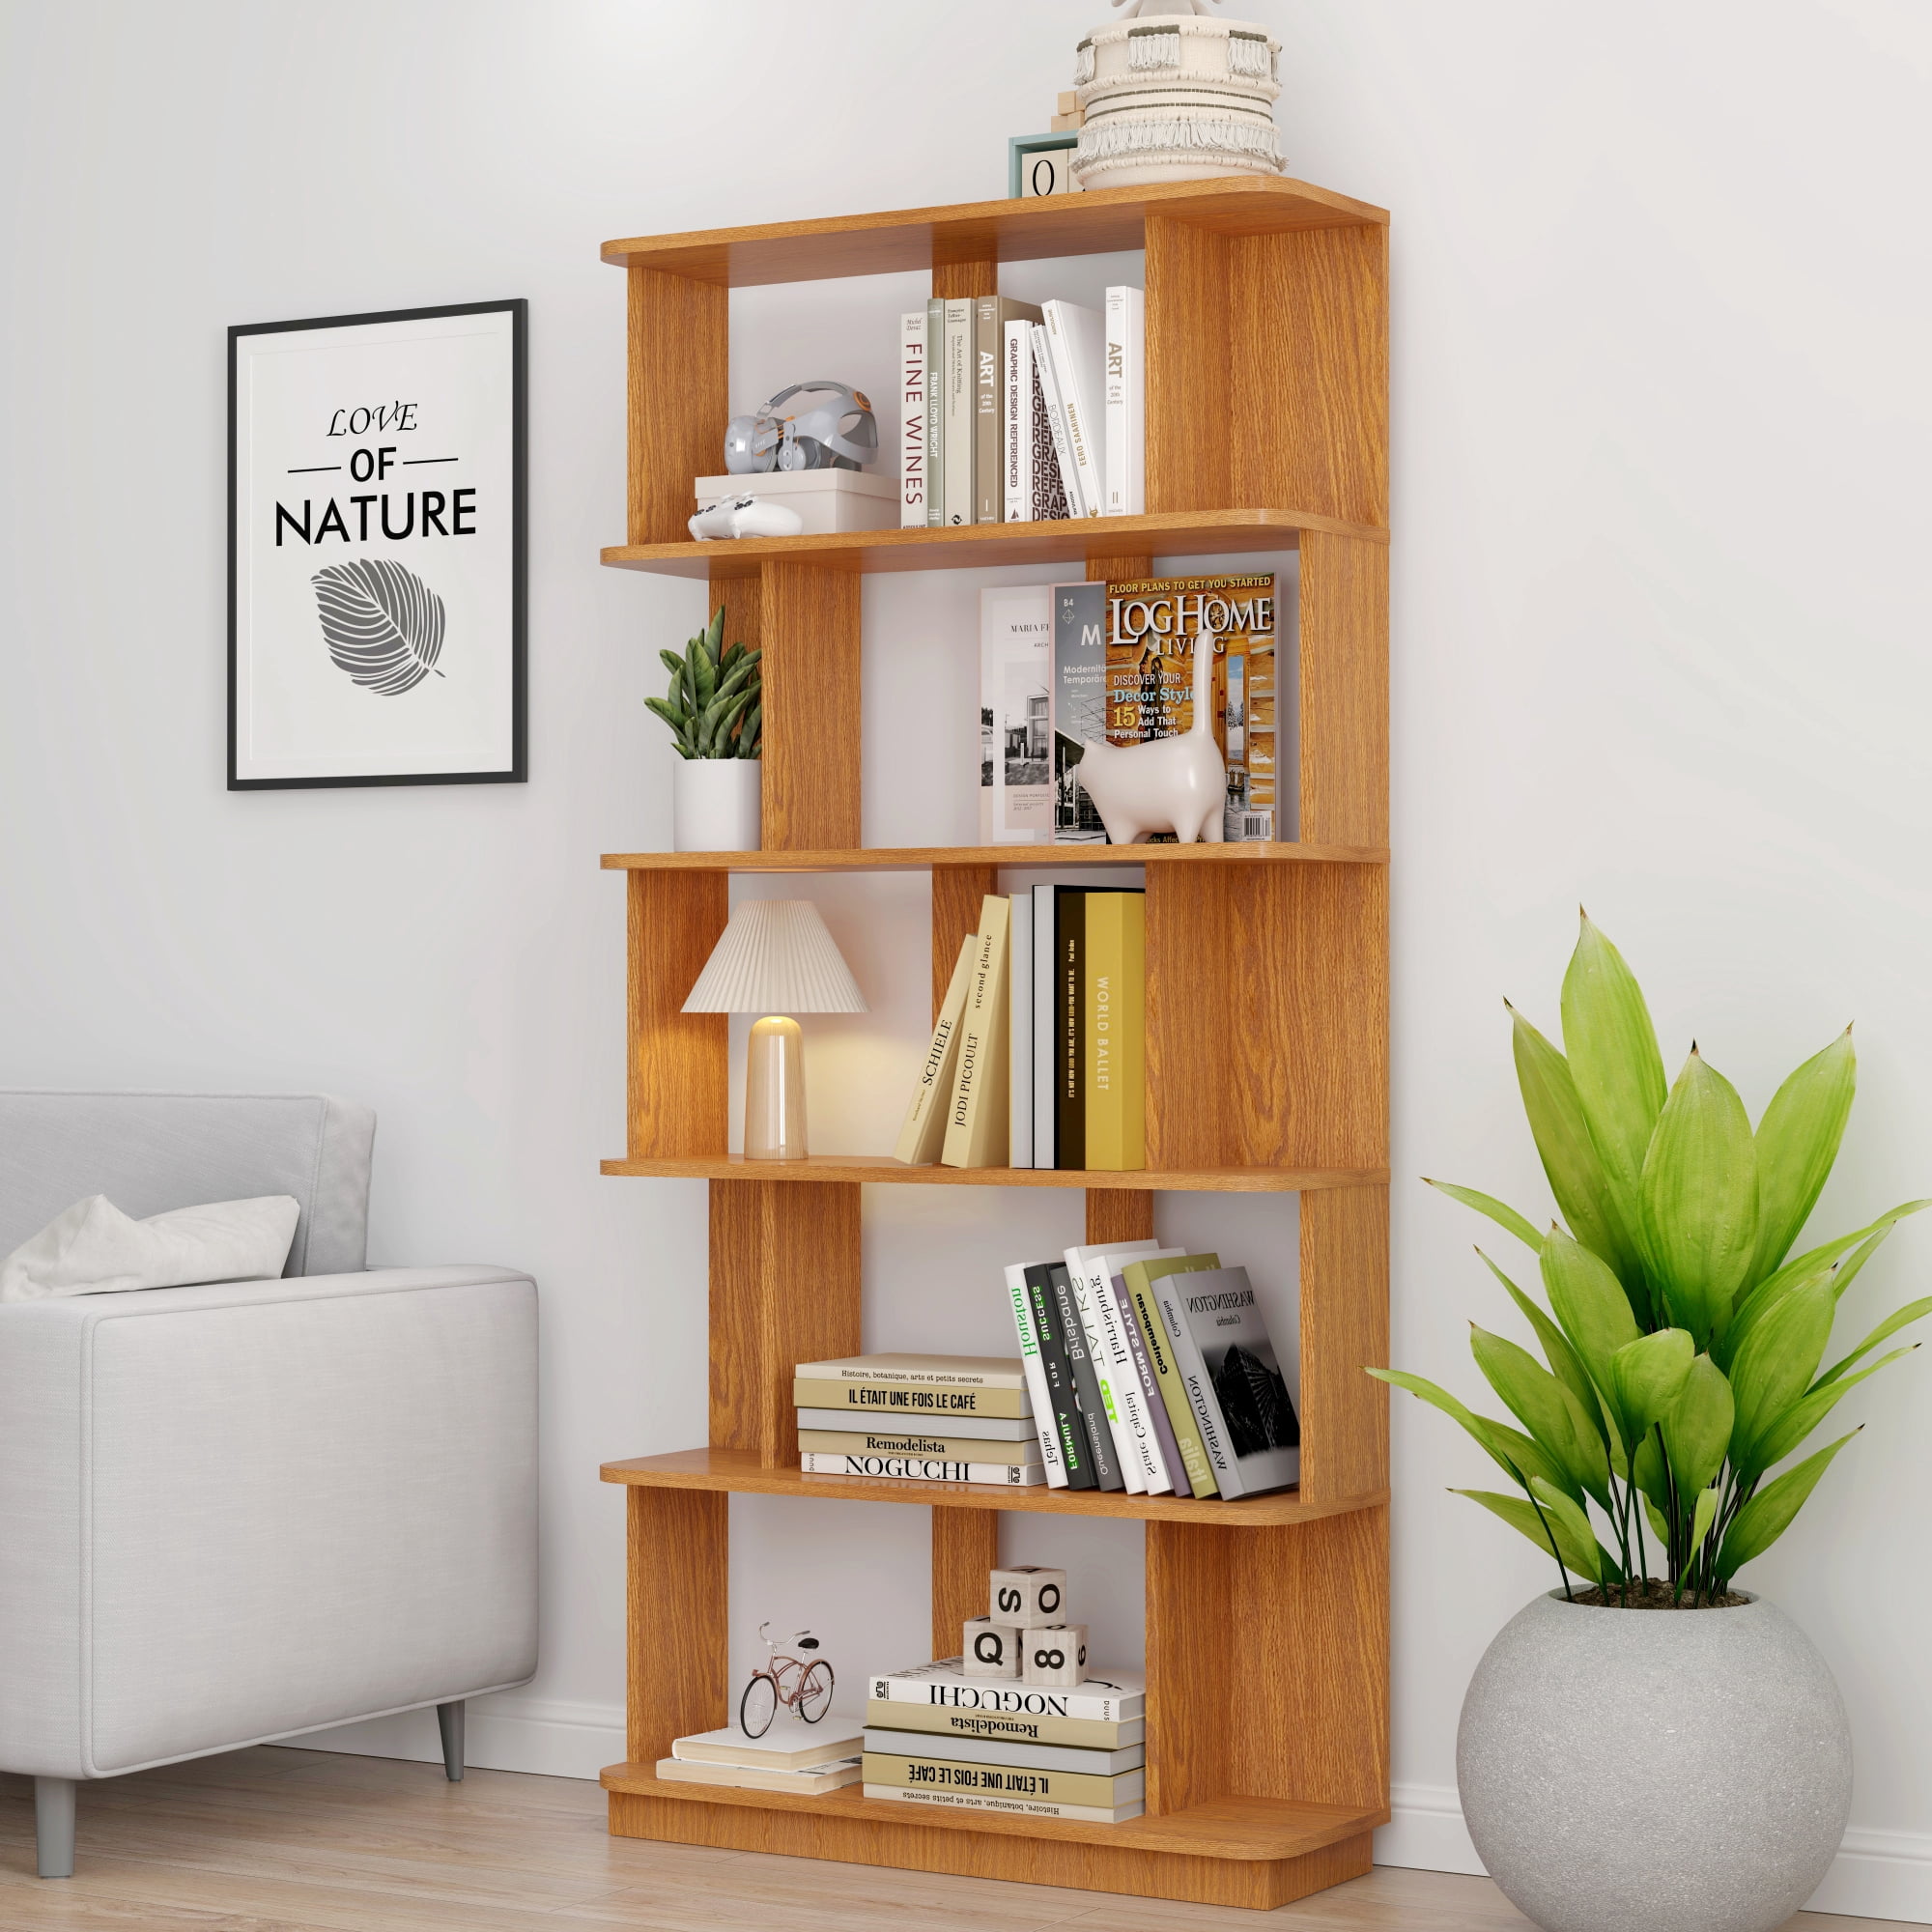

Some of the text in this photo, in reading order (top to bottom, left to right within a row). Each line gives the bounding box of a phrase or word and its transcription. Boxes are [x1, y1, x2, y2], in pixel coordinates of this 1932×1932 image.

[980, 351, 994, 386] ART
[1108, 342, 1122, 379] ART
[954, 368, 963, 393] Knitting
[326, 400, 418, 437] LOVE
[905, 343, 923, 505] FINE WINES
[929, 372, 938, 459] FRANK LLOYD WRIGHT
[1049, 404, 1066, 456] BORDEAUX
[1066, 403, 1087, 467] EERO SAARINEN
[350, 446, 397, 482] OF
[275, 488, 476, 547] NATURE
[1109, 577, 1270, 594] FLOOR PLANS TO GET YOU STARTED
[1010, 624, 1038, 633] MARIA
[1156, 637, 1226, 656] LIVIG
[1114, 672, 1180, 686] DISCOVER YOUR
[1113, 689, 1156, 703] Decor
[1113, 706, 1136, 726] 15
[1138, 704, 1171, 716] Ways to
[1138, 716, 1177, 726] Add That
[1114, 727, 1179, 739] Personal Touch
[975, 934, 992, 1009] second glance
[1096, 976, 1109, 1091] WORLD BALLET
[923, 1018, 953, 1087] SCHIELE
[954, 1033, 979, 1127] JODI PICOULT
[841, 1370, 870, 1379] Histoire,
[872, 1371, 909, 1381] botanique,
[935, 1374, 956, 1383] petits
[957, 1376, 983, 1384] secrets
[848, 1386, 976, 1410] IL ÉTAIT UNE FOIS LE CAFÉ
[867, 1436, 946, 1454] Remodelista
[844, 1455, 971, 1482] NOGUCHI
[974, 1632, 1004, 1666] Q
[1034, 1649, 1065, 1670] 8
[929, 1684, 1068, 1718] NOGUCHI
[950, 1717, 1039, 1739] Remodelista
[908, 1764, 1049, 1796] IL ÉTAIT UNE FOIS LE CAFÉ
[902, 1792, 1060, 1815] Histoire, botanique, arts et petits secrets
